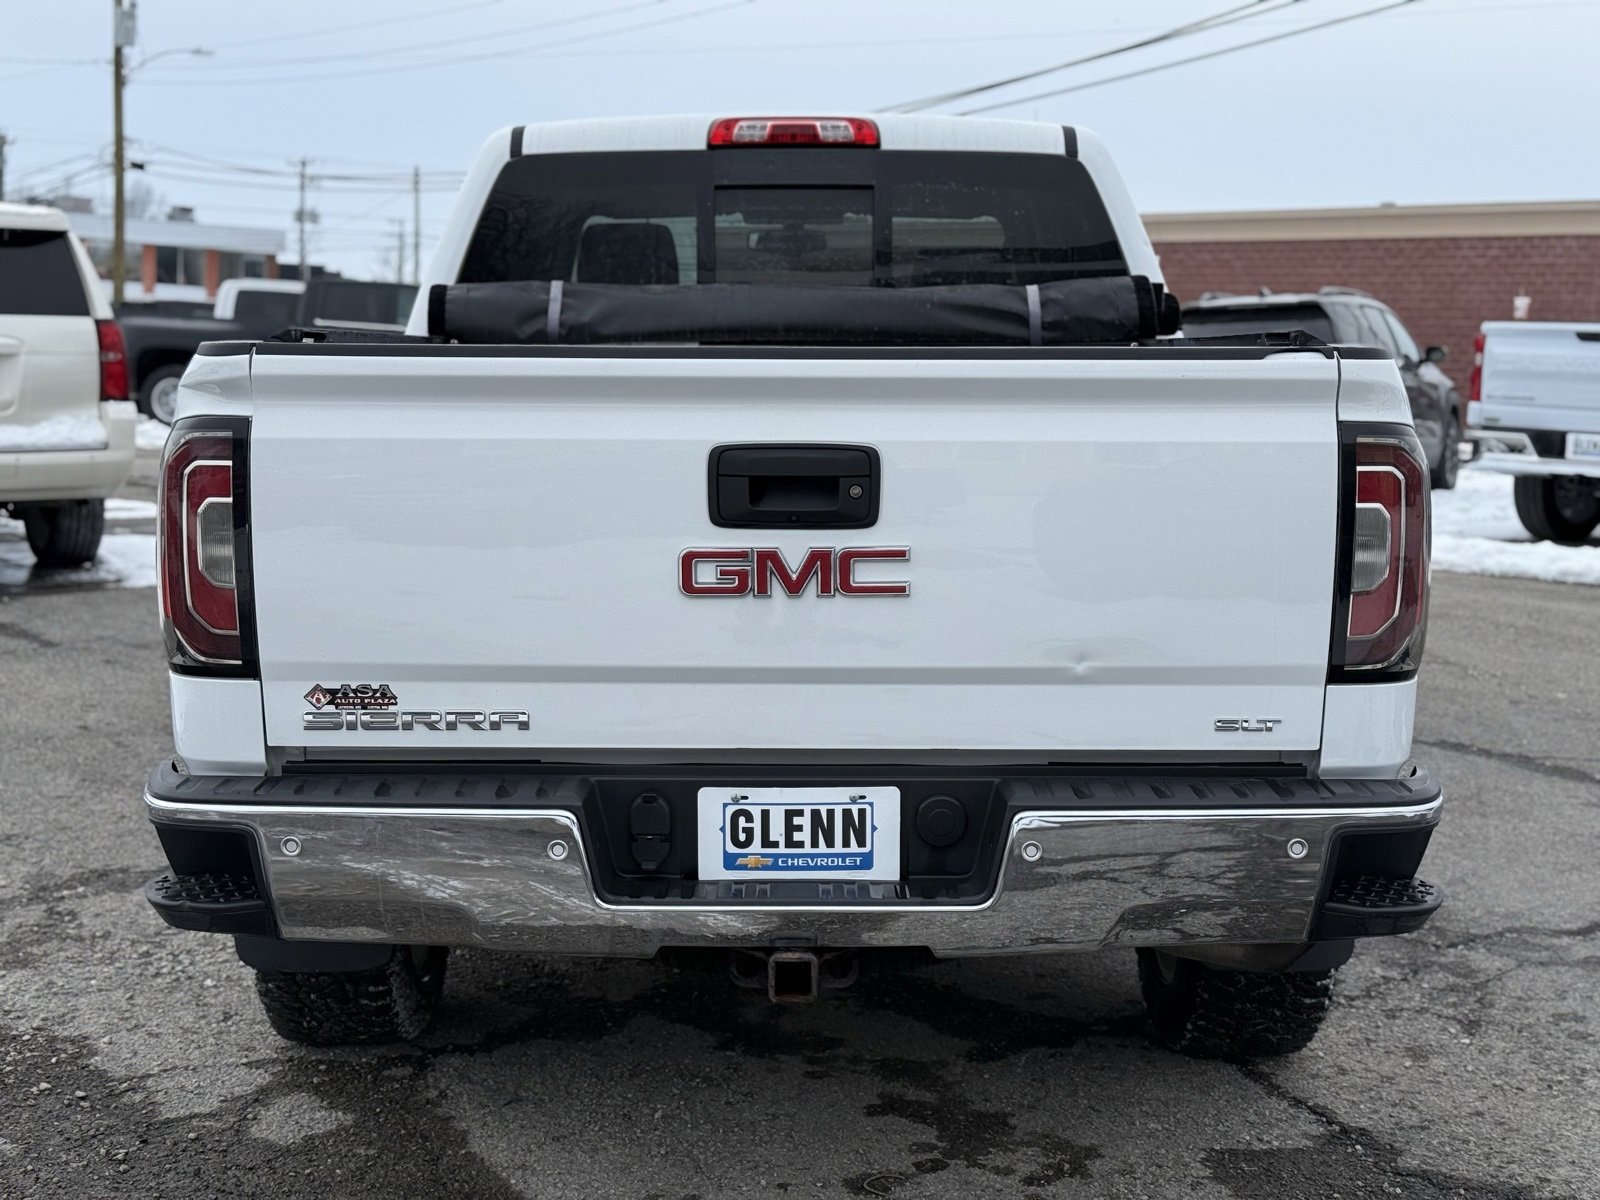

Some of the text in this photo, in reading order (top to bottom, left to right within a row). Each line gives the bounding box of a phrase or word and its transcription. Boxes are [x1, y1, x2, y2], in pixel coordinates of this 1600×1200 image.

[678, 546, 911, 597] GMC
[335, 684, 395, 697] ASA
[303, 709, 530, 731] SIERRA
[1214, 718, 1282, 732] SLT
[729, 808, 867, 850] GLENN
[778, 857, 863, 867] CHEVROLET
